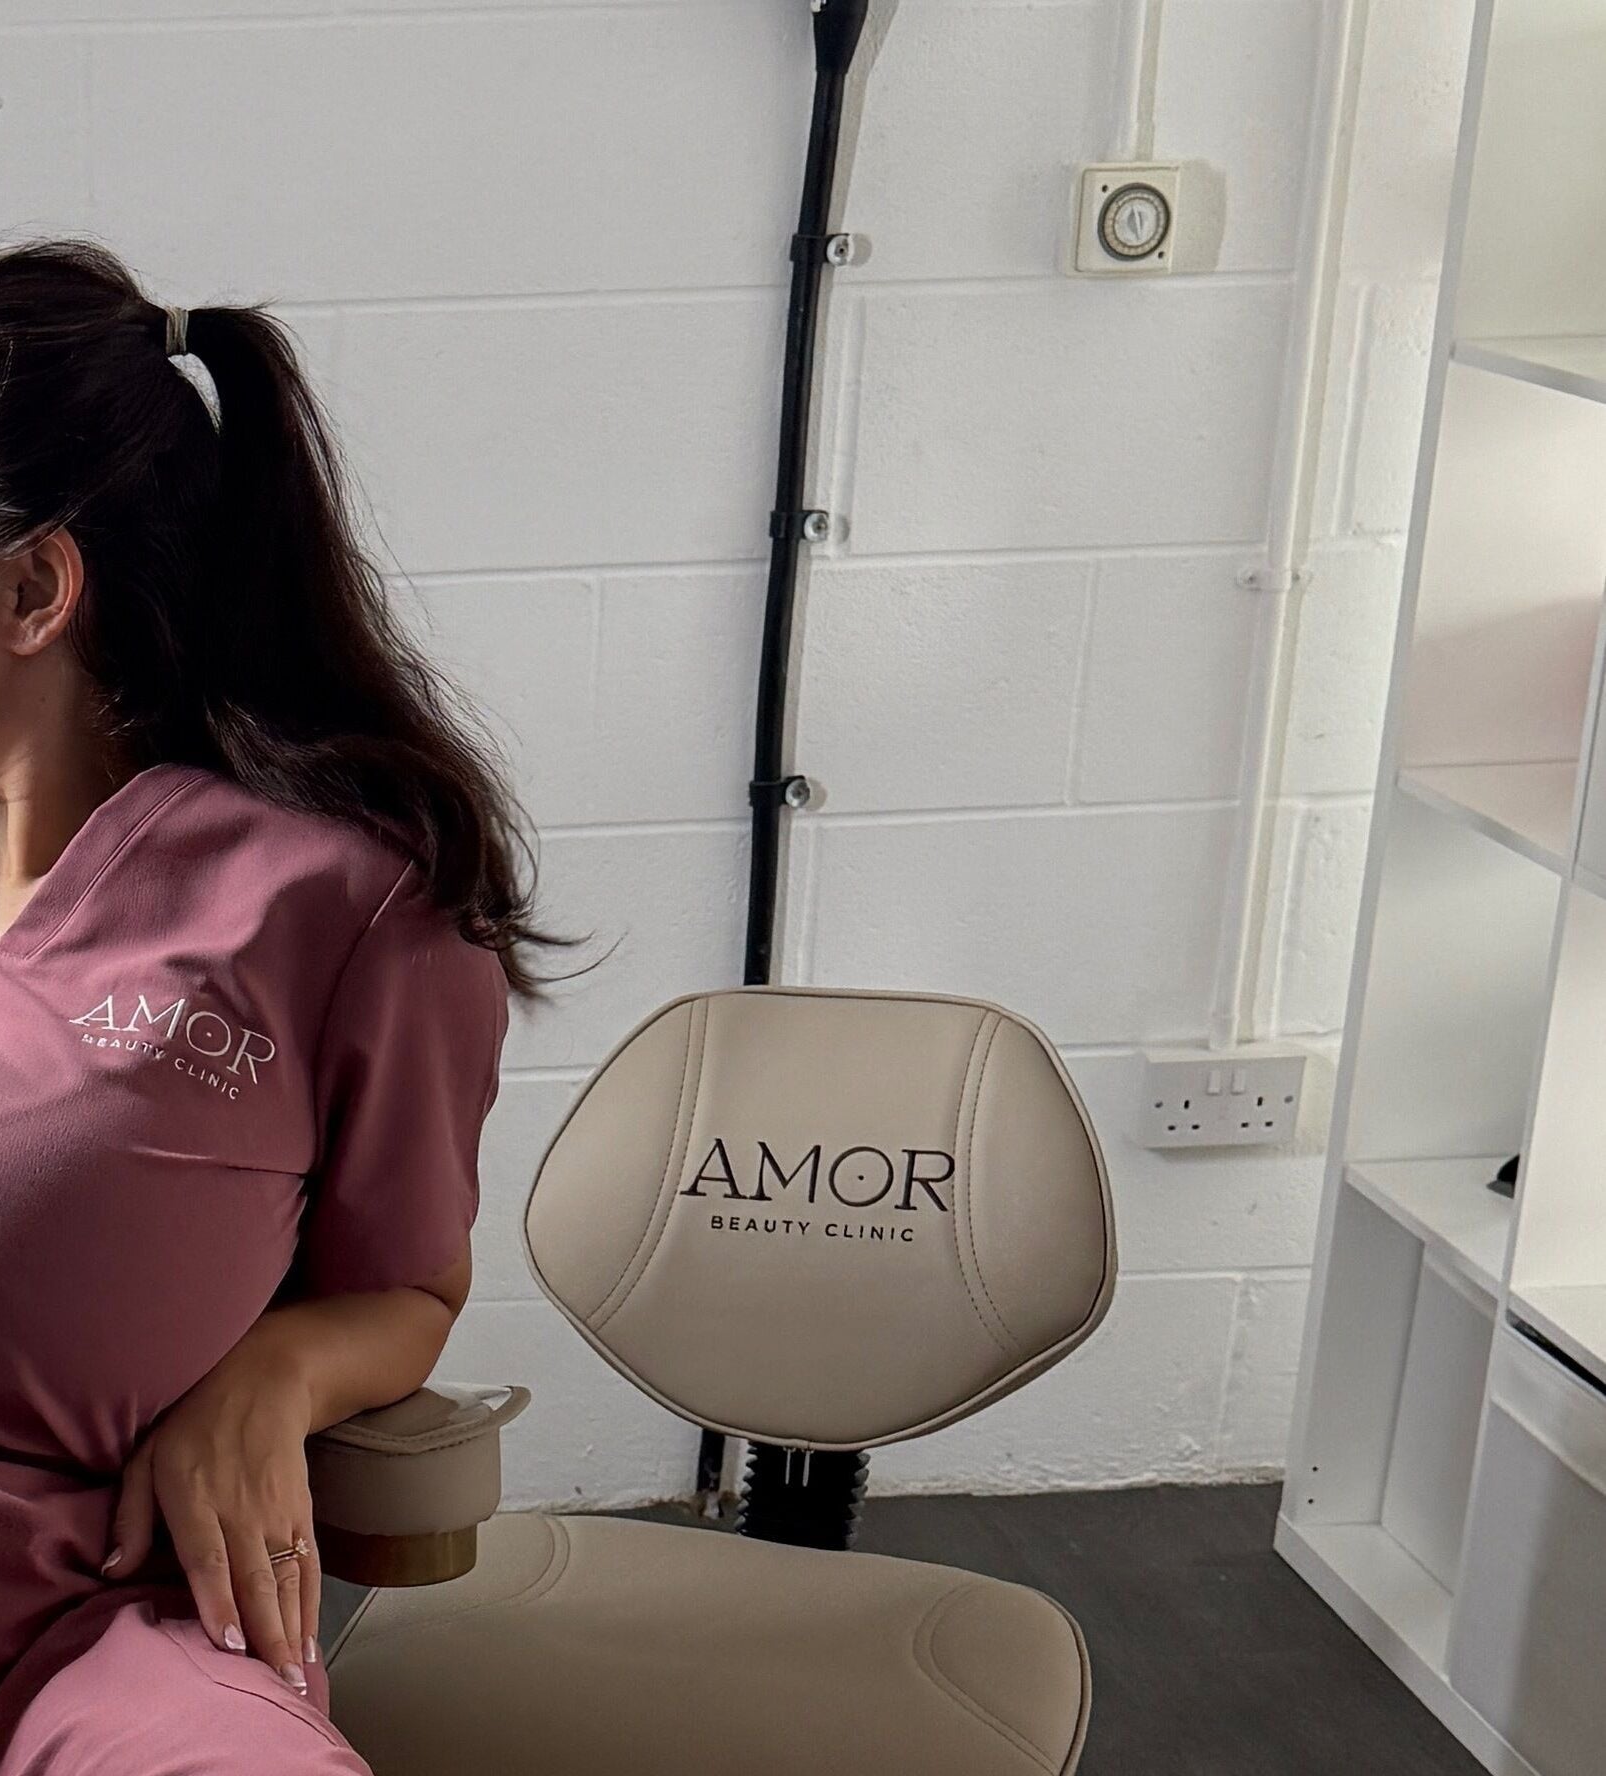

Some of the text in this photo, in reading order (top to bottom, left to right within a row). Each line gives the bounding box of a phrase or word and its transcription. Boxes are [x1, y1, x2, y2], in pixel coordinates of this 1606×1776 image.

[69, 995, 275, 1084] AMOR
[82, 1033, 240, 1100] BEAUTY CLINIC
[680, 1138, 955, 1212] AMOR
[711, 1215, 914, 1242] BEAUTY CLINIC
